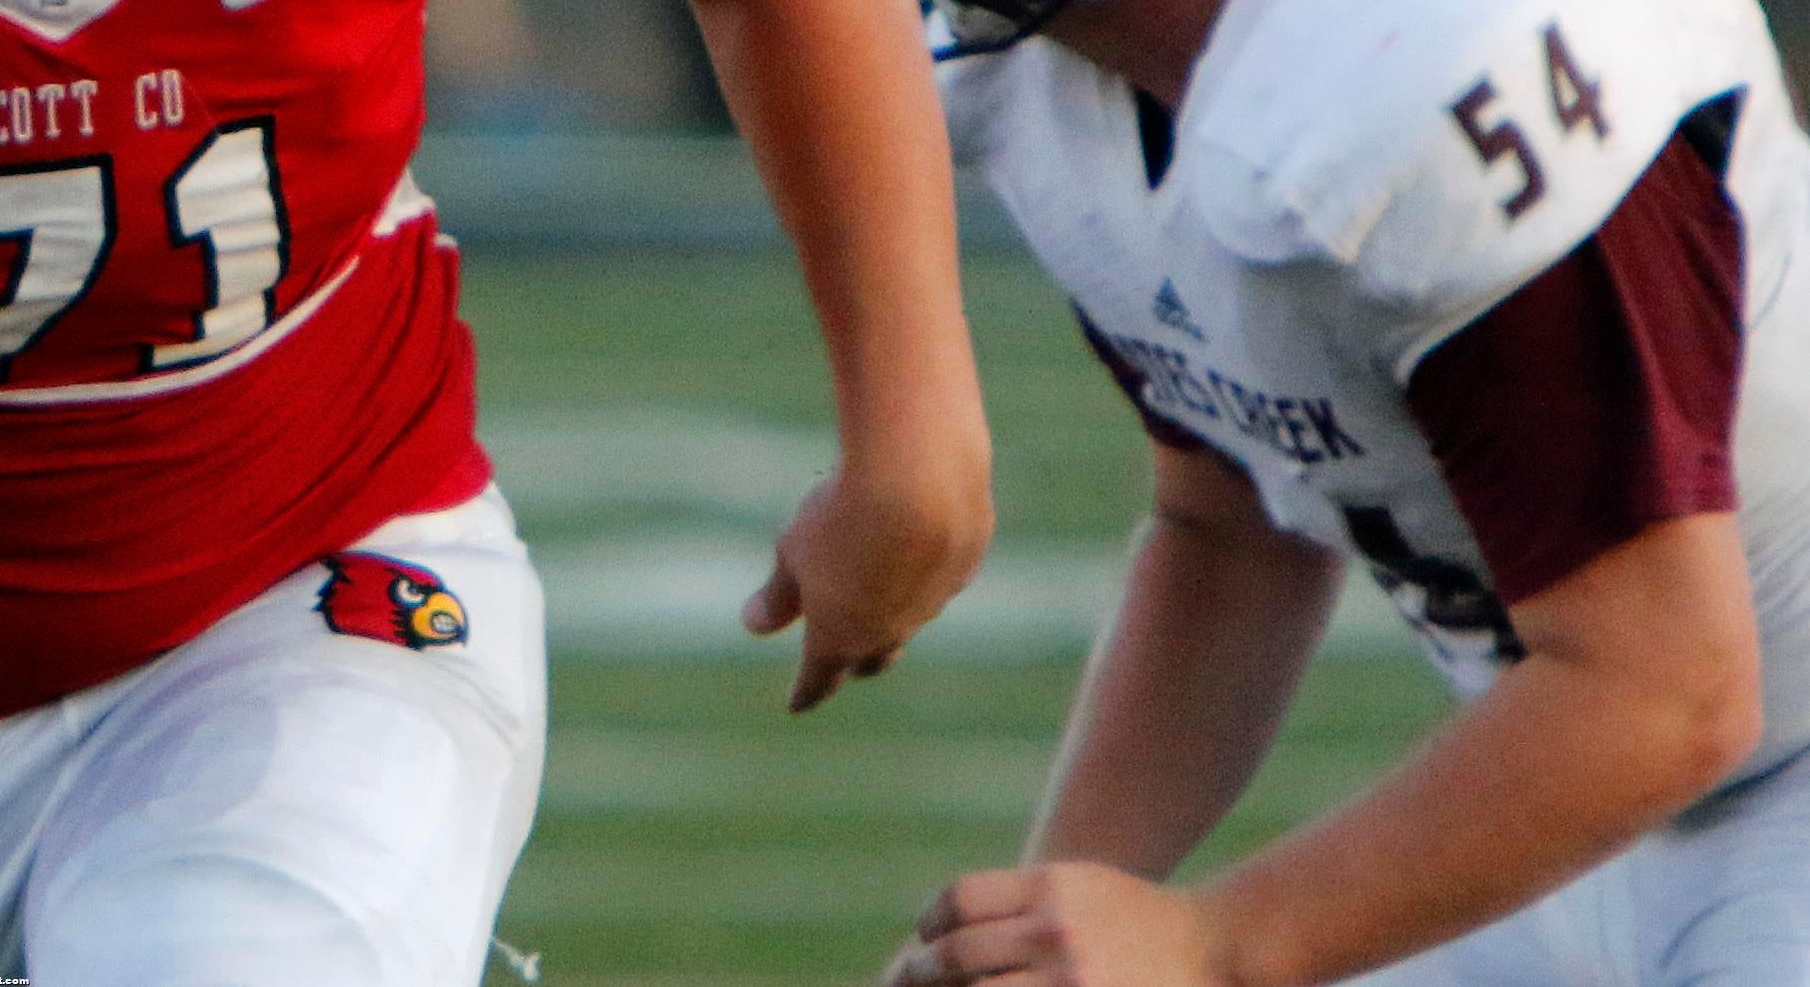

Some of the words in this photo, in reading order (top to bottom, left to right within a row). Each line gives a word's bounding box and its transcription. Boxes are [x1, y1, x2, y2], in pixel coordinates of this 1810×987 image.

[135, 69, 184, 129] CO
[1445, 20, 1610, 220] 54
[1206, 368, 1365, 461] CREEK
